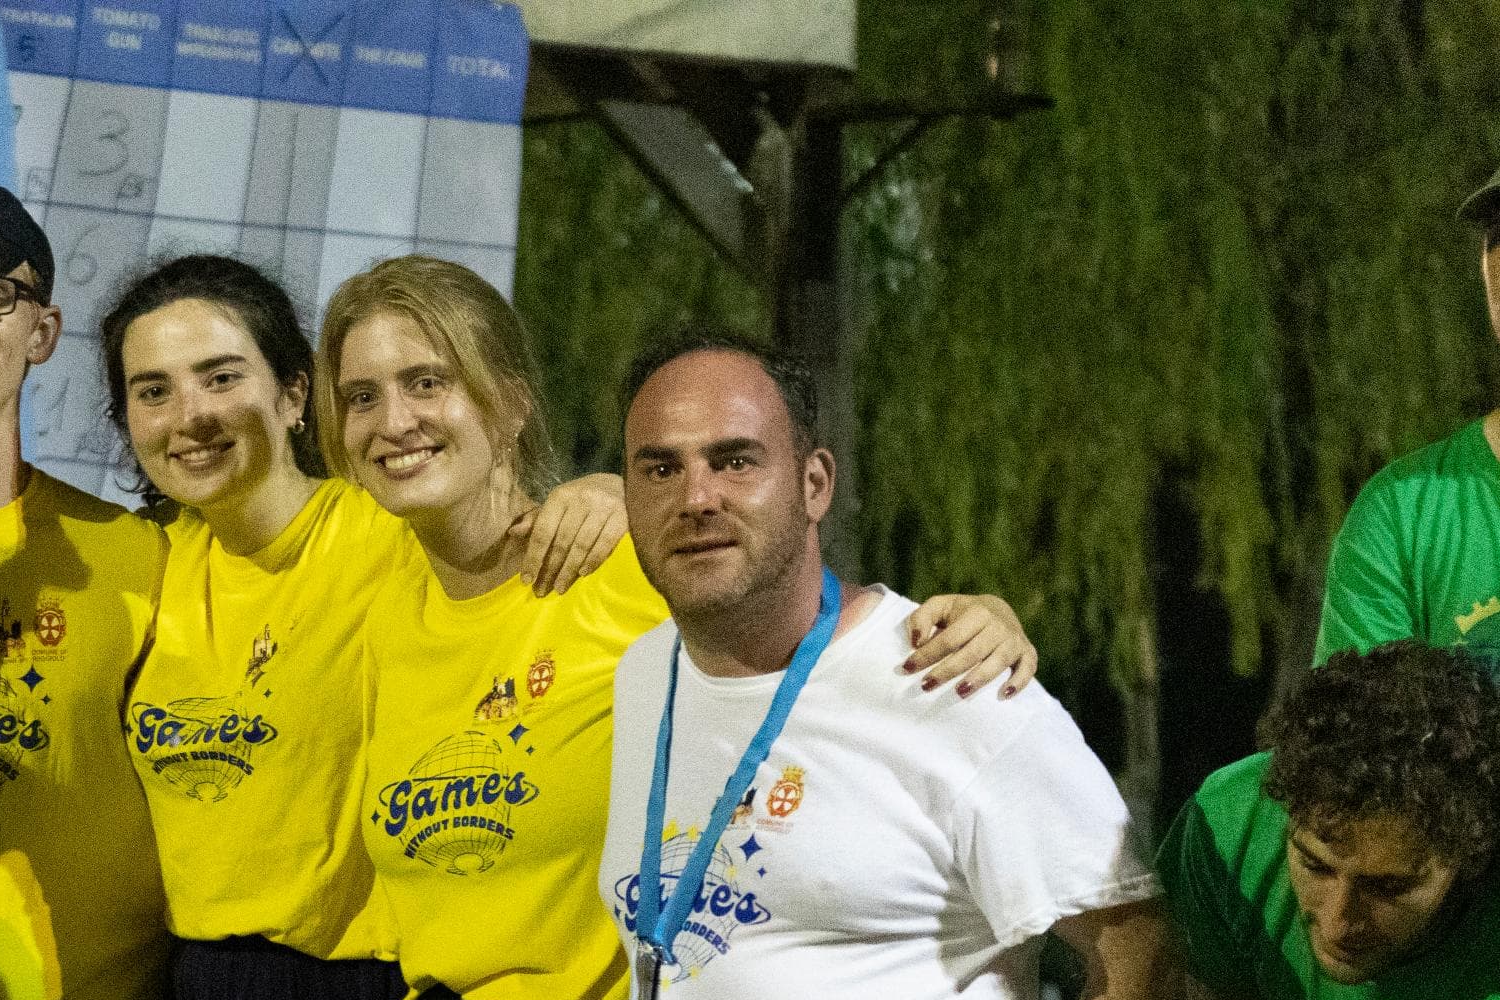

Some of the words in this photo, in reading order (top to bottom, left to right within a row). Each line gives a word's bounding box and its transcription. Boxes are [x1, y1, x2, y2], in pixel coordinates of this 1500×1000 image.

[190, 750, 255, 776] BORDERS
[384, 771, 529, 837] Games
[404, 818, 450, 860] WITHOUT
[453, 815, 516, 841] BORDERS
[682, 920, 731, 956] ORDERS
